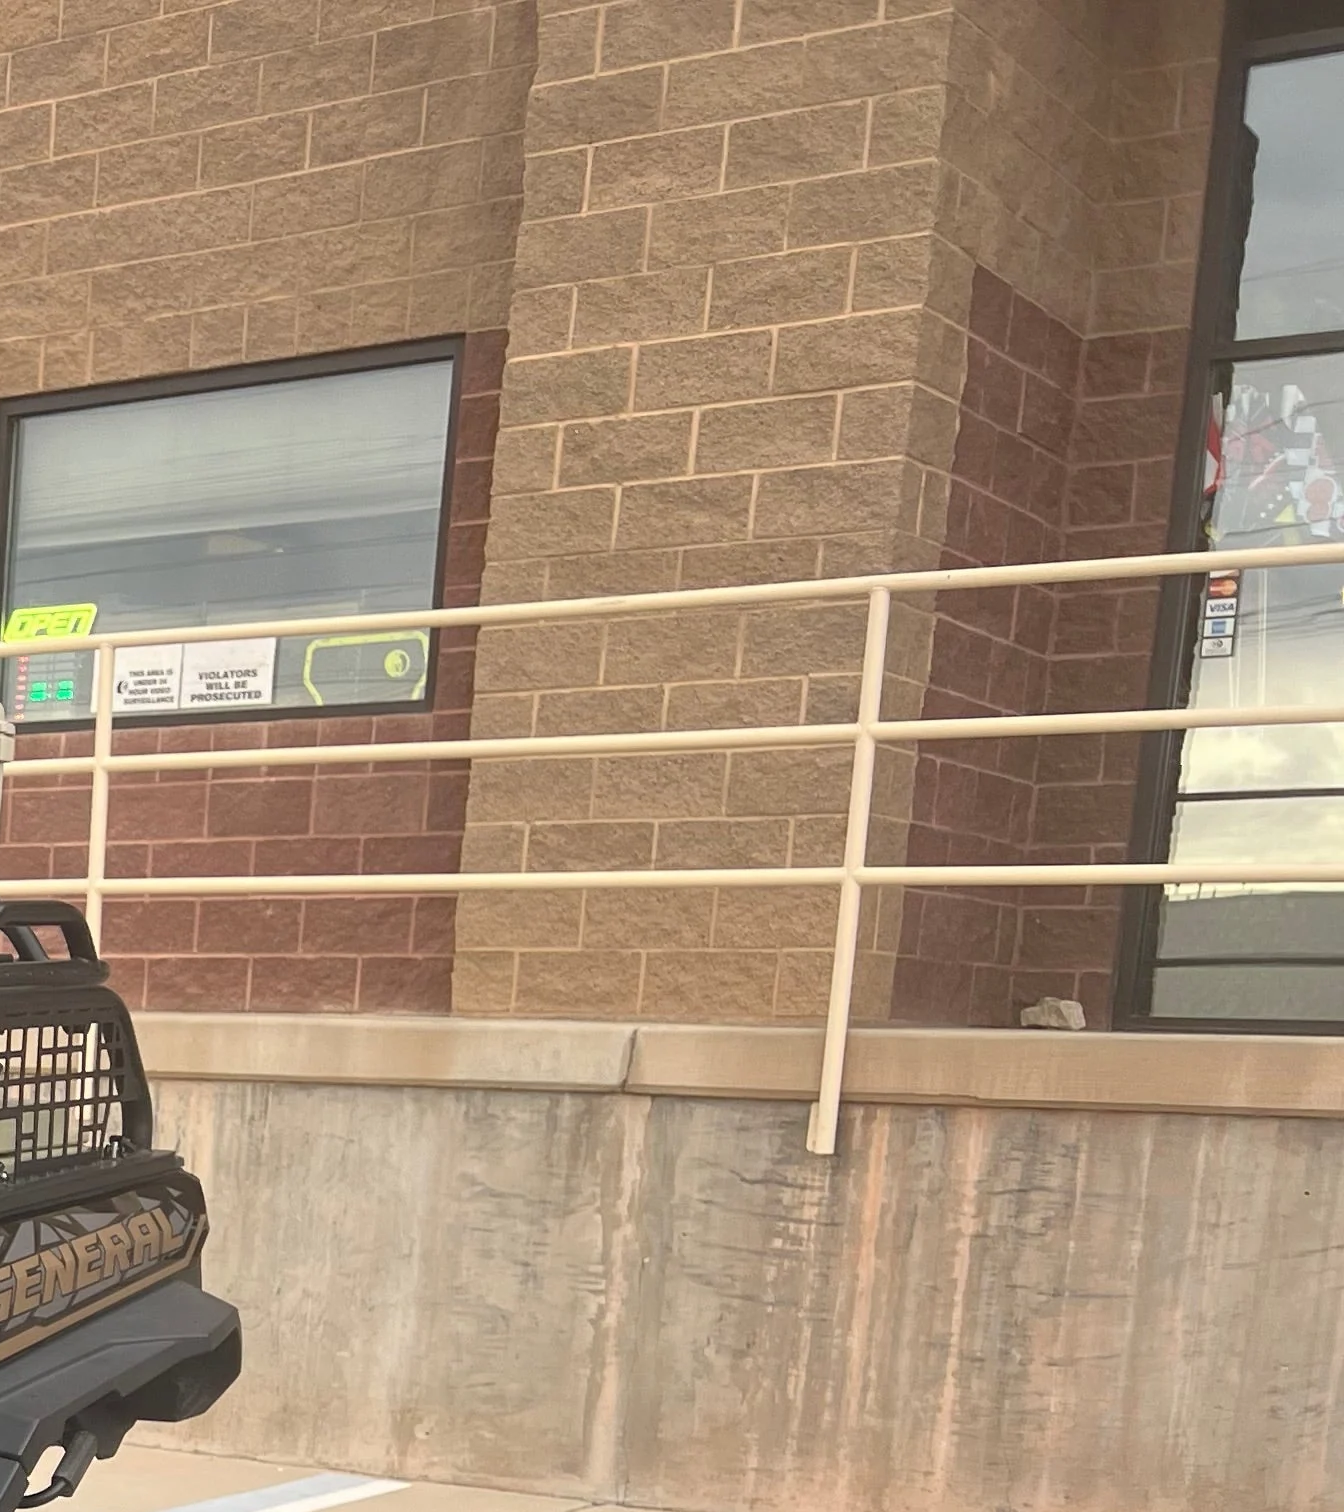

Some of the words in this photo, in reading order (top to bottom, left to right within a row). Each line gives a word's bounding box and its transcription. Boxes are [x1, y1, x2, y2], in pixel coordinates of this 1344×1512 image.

[1209, 603, 1235, 613] VISA
[11, 609, 91, 639] OPEN
[166, 668, 174, 676] IS
[198, 668, 258, 681] VIOLATORS
[205, 680, 231, 691] WILL
[234, 679, 248, 690] BE
[190, 690, 263, 703] PROSECUTED
